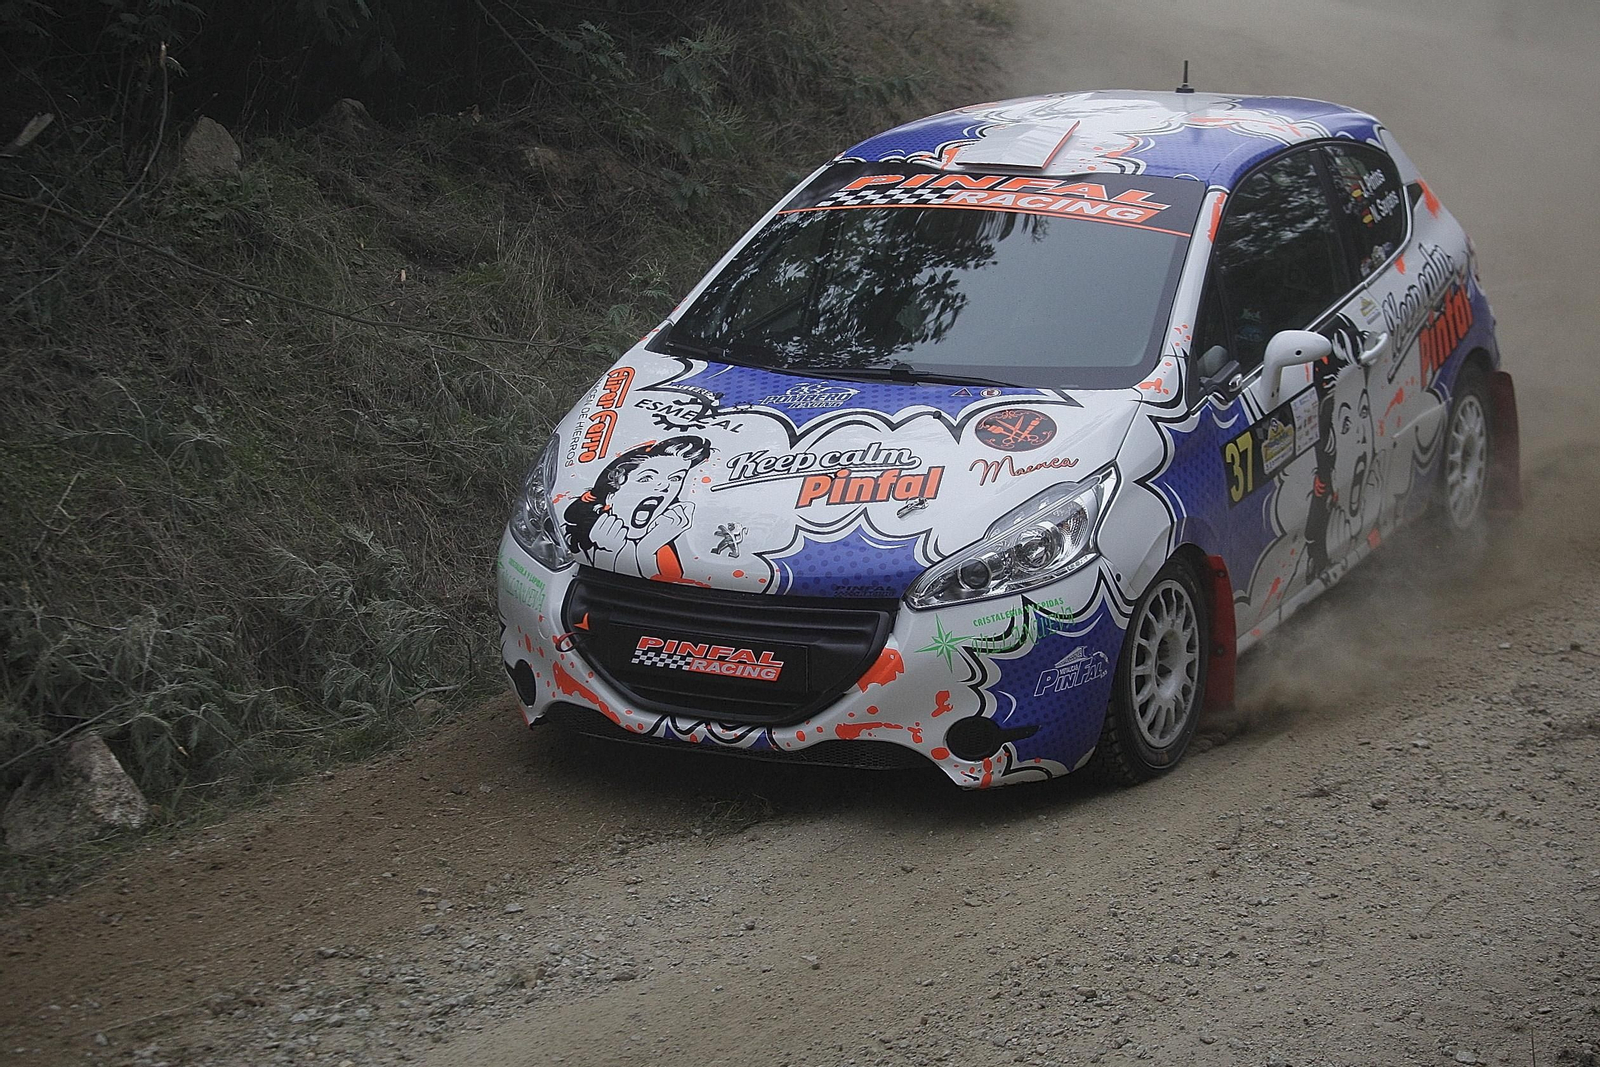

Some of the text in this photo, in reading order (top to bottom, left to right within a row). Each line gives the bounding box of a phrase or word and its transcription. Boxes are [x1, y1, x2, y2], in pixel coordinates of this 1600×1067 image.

[843, 173, 1172, 211] PINFAL
[950, 190, 1148, 221] RACING
[1418, 280, 1473, 392] Pinfal
[564, 421, 586, 468] HIERROS
[726, 441, 922, 482] Keep calm
[794, 465, 946, 509] Pinfal
[1225, 431, 1253, 502] 37
[634, 635, 784, 667] PINFAL
[692, 660, 778, 680] RACING
